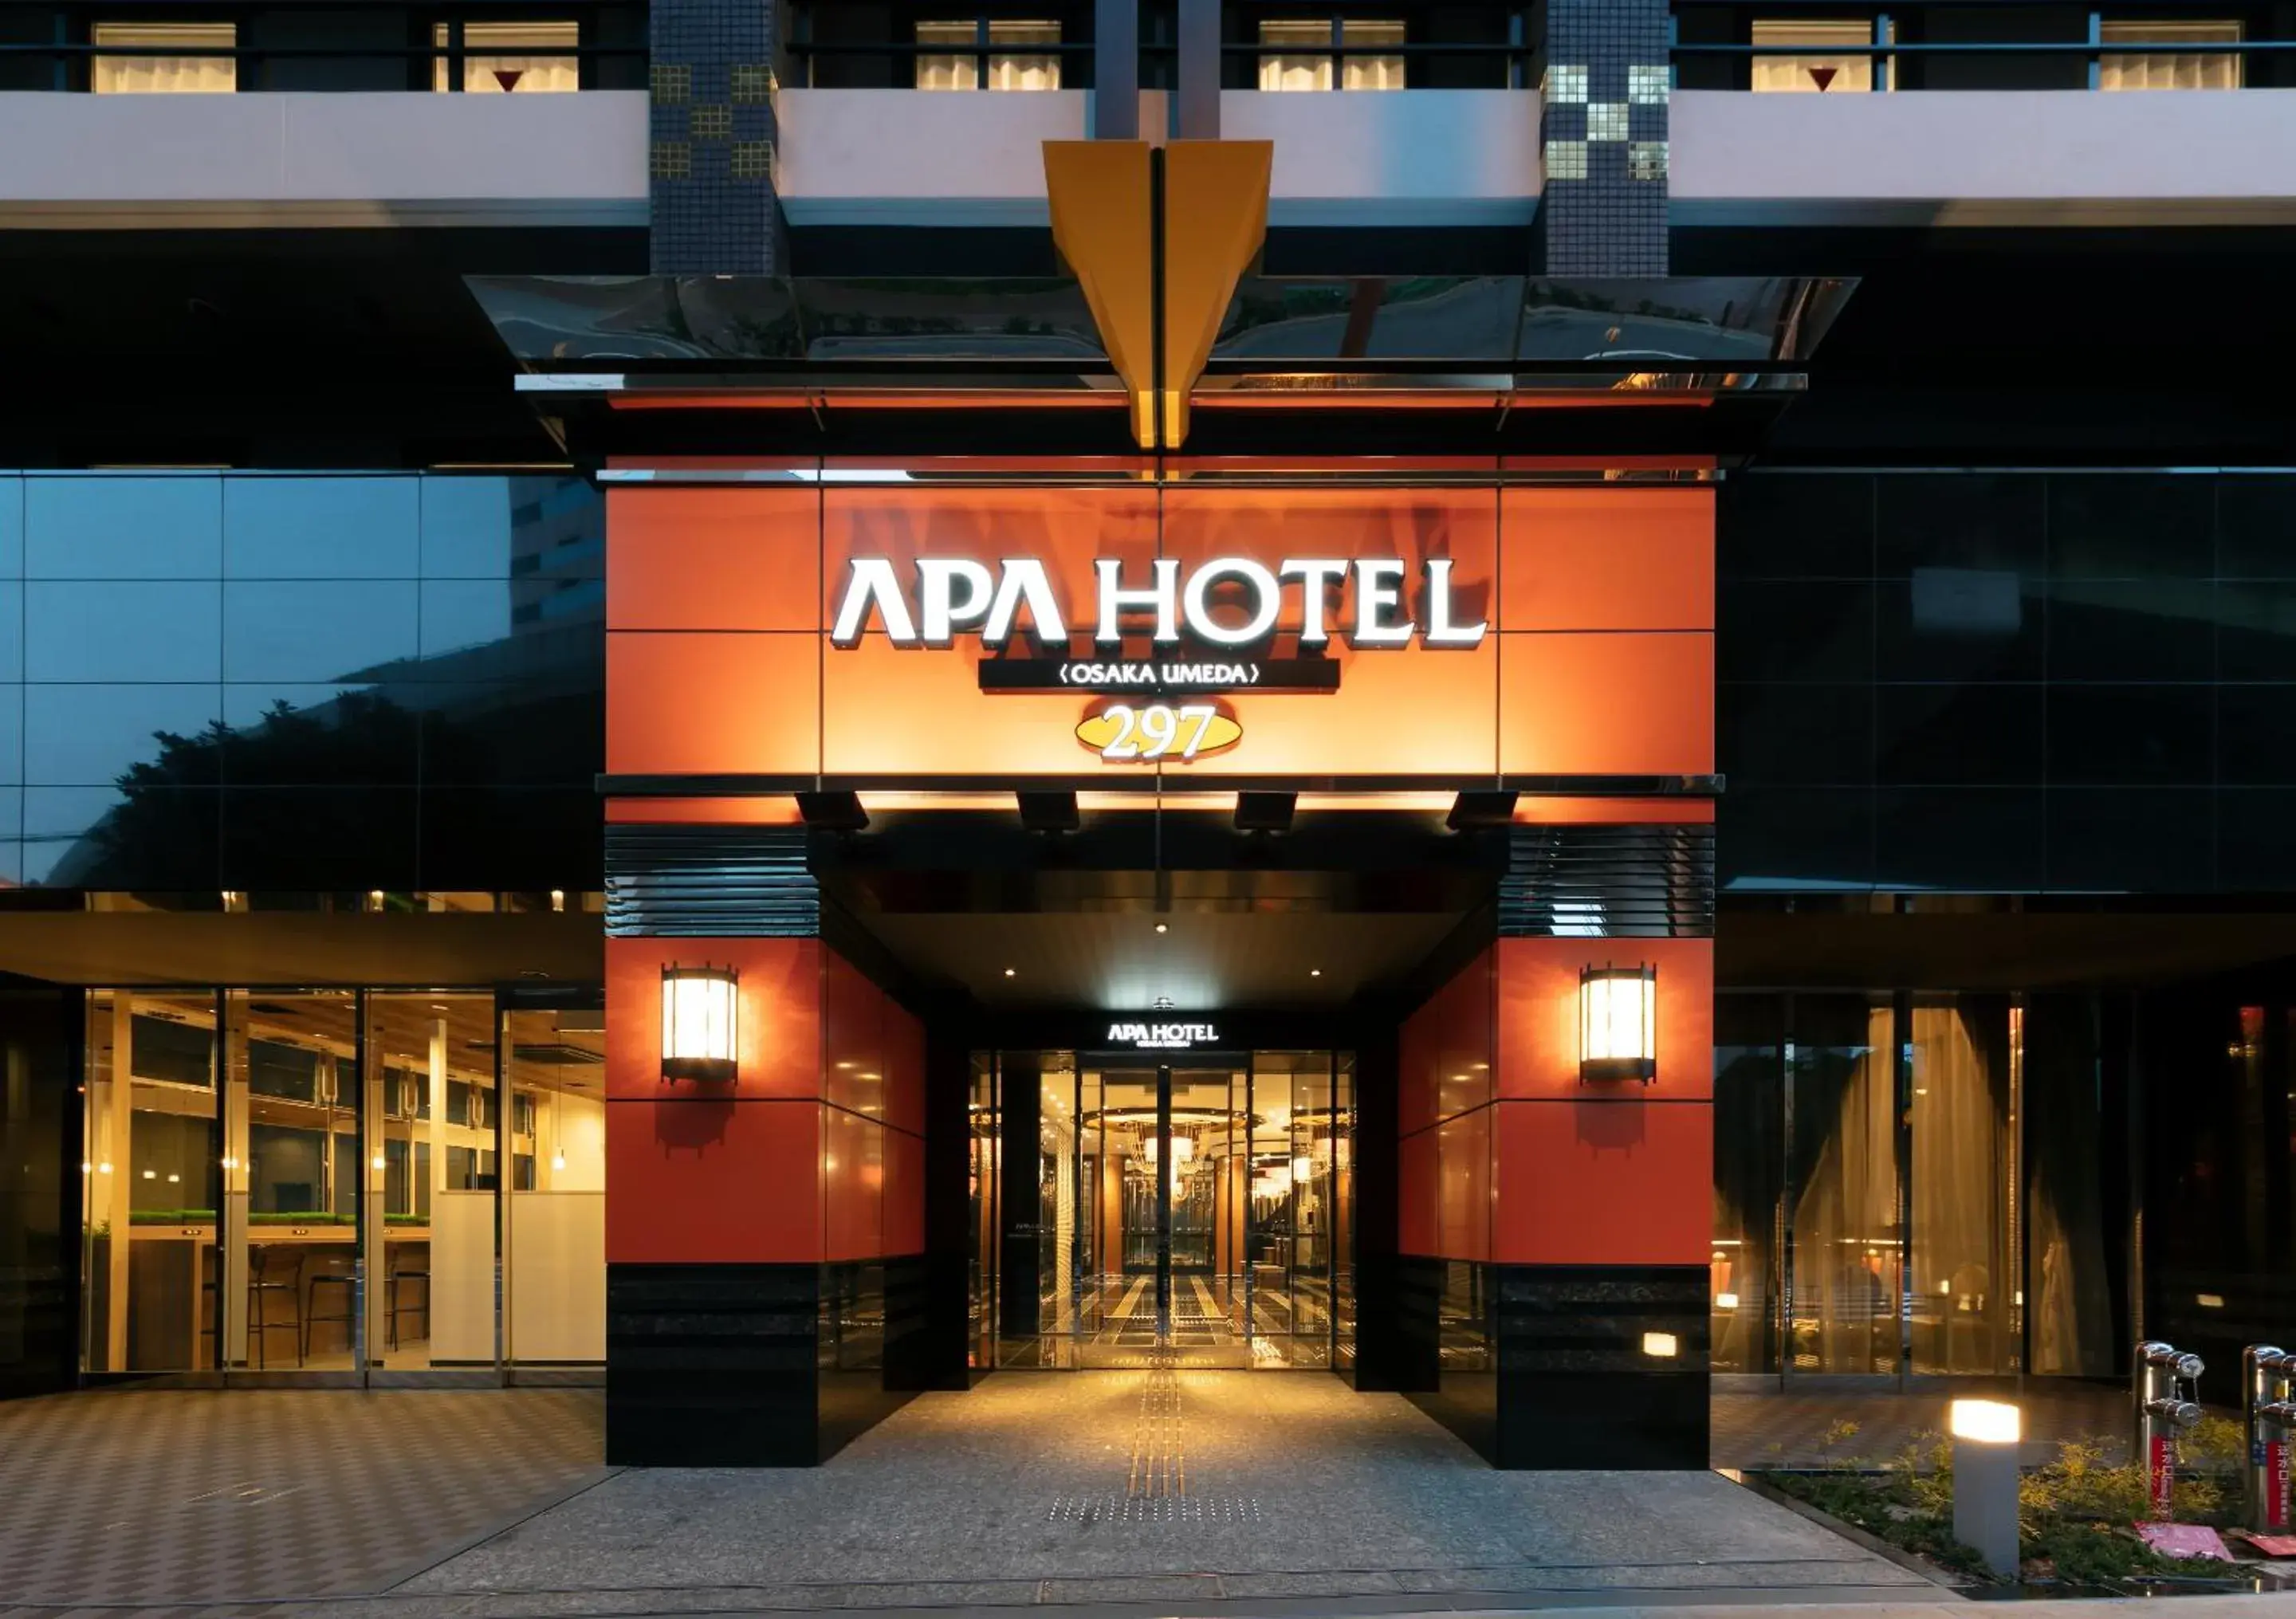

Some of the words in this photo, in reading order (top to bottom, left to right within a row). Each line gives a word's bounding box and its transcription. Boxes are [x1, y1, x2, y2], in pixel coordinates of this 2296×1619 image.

[831, 558, 1068, 644] APA
[1094, 556, 1489, 644] HOTEL
[1101, 705, 1217, 758] 297
[1107, 1024, 1149, 1041] APA
[1151, 1024, 1220, 1041] HOTEL
